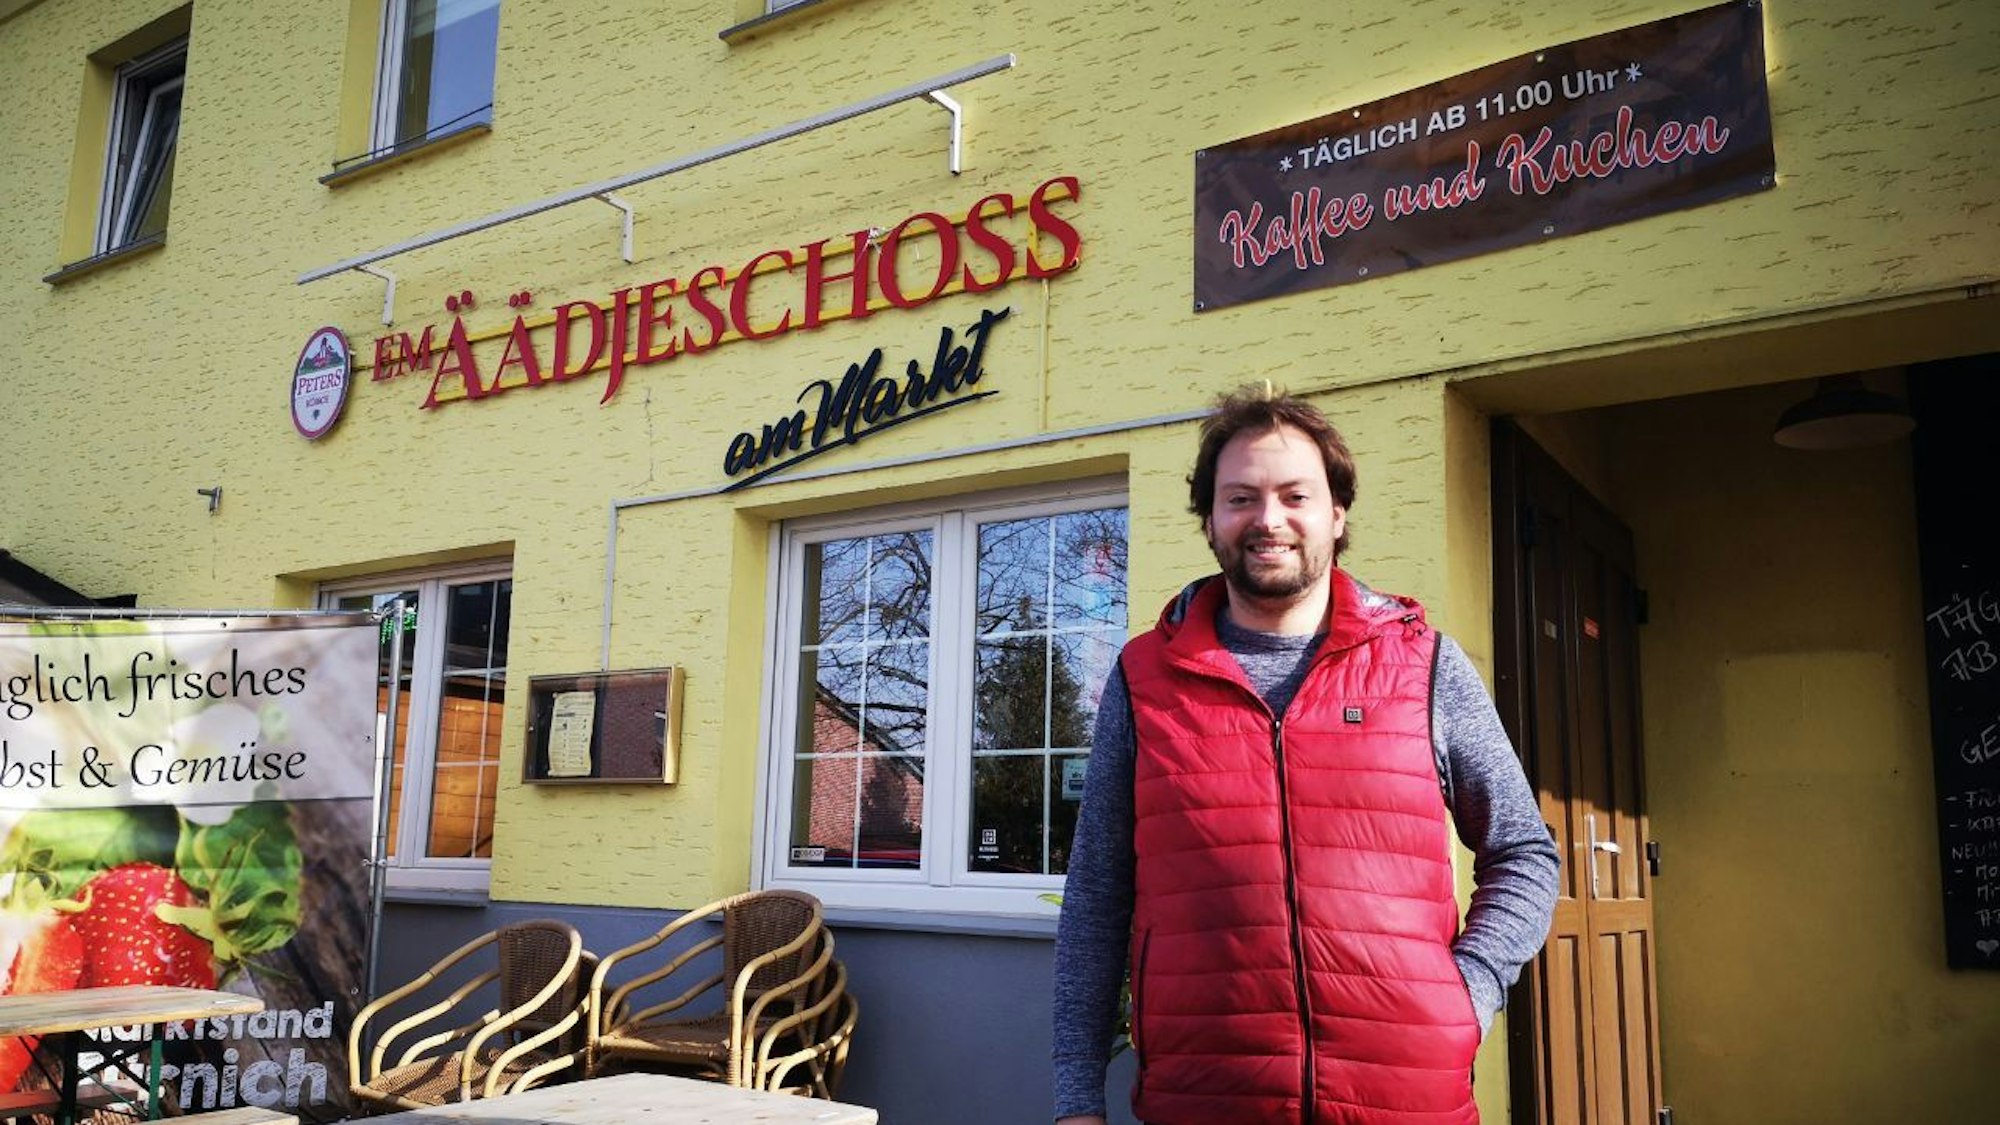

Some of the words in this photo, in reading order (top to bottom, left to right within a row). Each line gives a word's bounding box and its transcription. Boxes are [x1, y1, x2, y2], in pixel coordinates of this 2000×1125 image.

[1298, 118, 1417, 169] TÄGLICH
[1426, 105, 1467, 136] AB
[1476, 80, 1553, 120] 11.00
[1562, 69, 1620, 99] Uhr
[1219, 186, 1374, 270] Kaffee
[1384, 140, 1486, 220] und
[1496, 105, 1730, 195] Kuchen
[372, 324, 437, 382] EM
[418, 175, 1083, 409] ÄÄDJESCHOSS
[297, 368, 343, 396] PETERS
[724, 409, 807, 476] am
[797, 306, 1011, 445] Markt
[0, 653, 116, 720] glich
[118, 648, 307, 718] frisches
[79, 746, 117, 788] &
[131, 741, 307, 787] Gemüse
